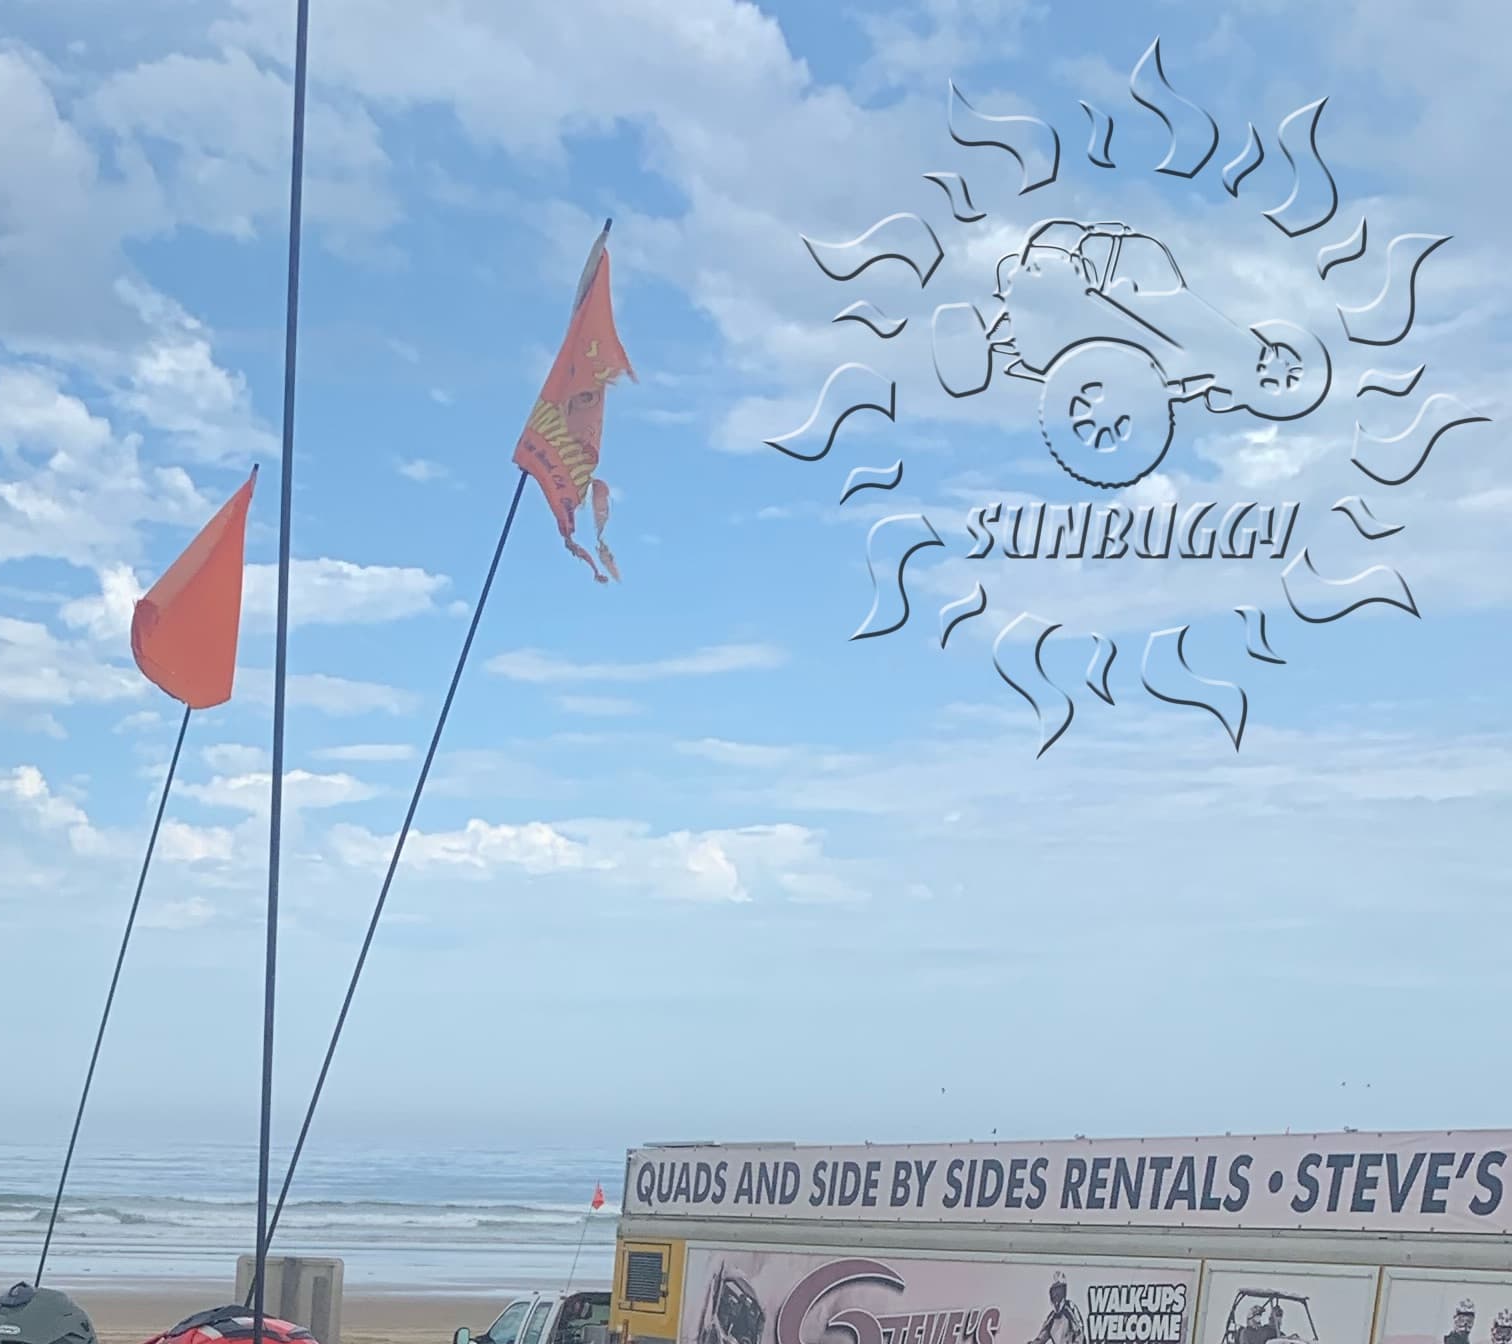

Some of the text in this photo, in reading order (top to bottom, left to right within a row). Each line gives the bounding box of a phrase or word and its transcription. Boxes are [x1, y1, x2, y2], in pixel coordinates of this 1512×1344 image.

[635, 1151, 1508, 1216] QUADS AND SIDE BY SIDES RENTALS STEVE'S
[1088, 1283, 1187, 1314] WALK-UPS
[1087, 1312, 1183, 1344] WELCOME
